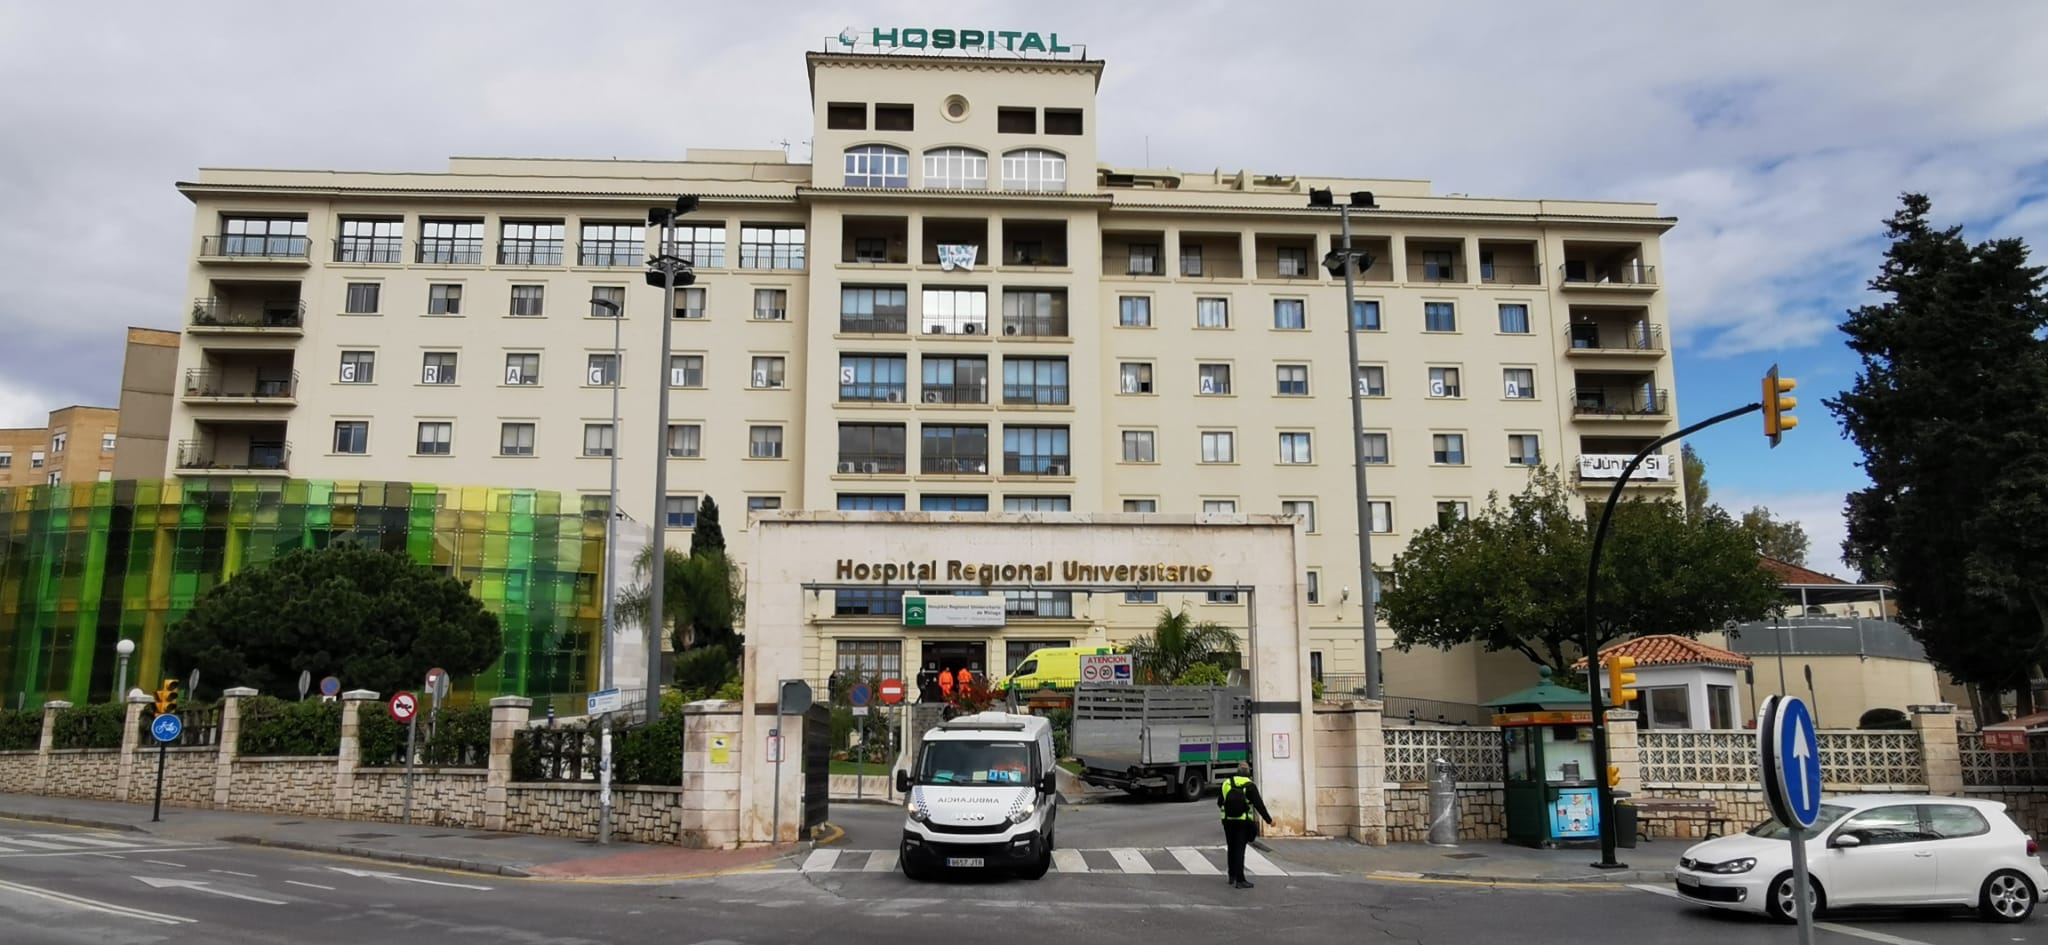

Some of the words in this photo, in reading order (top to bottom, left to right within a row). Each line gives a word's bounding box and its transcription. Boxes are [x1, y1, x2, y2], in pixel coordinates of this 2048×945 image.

[873, 27, 1071, 53] HOSPITAL
[836, 559, 937, 586] Hospital
[947, 560, 1053, 587] Regional
[1063, 560, 1213, 582] Universitario
